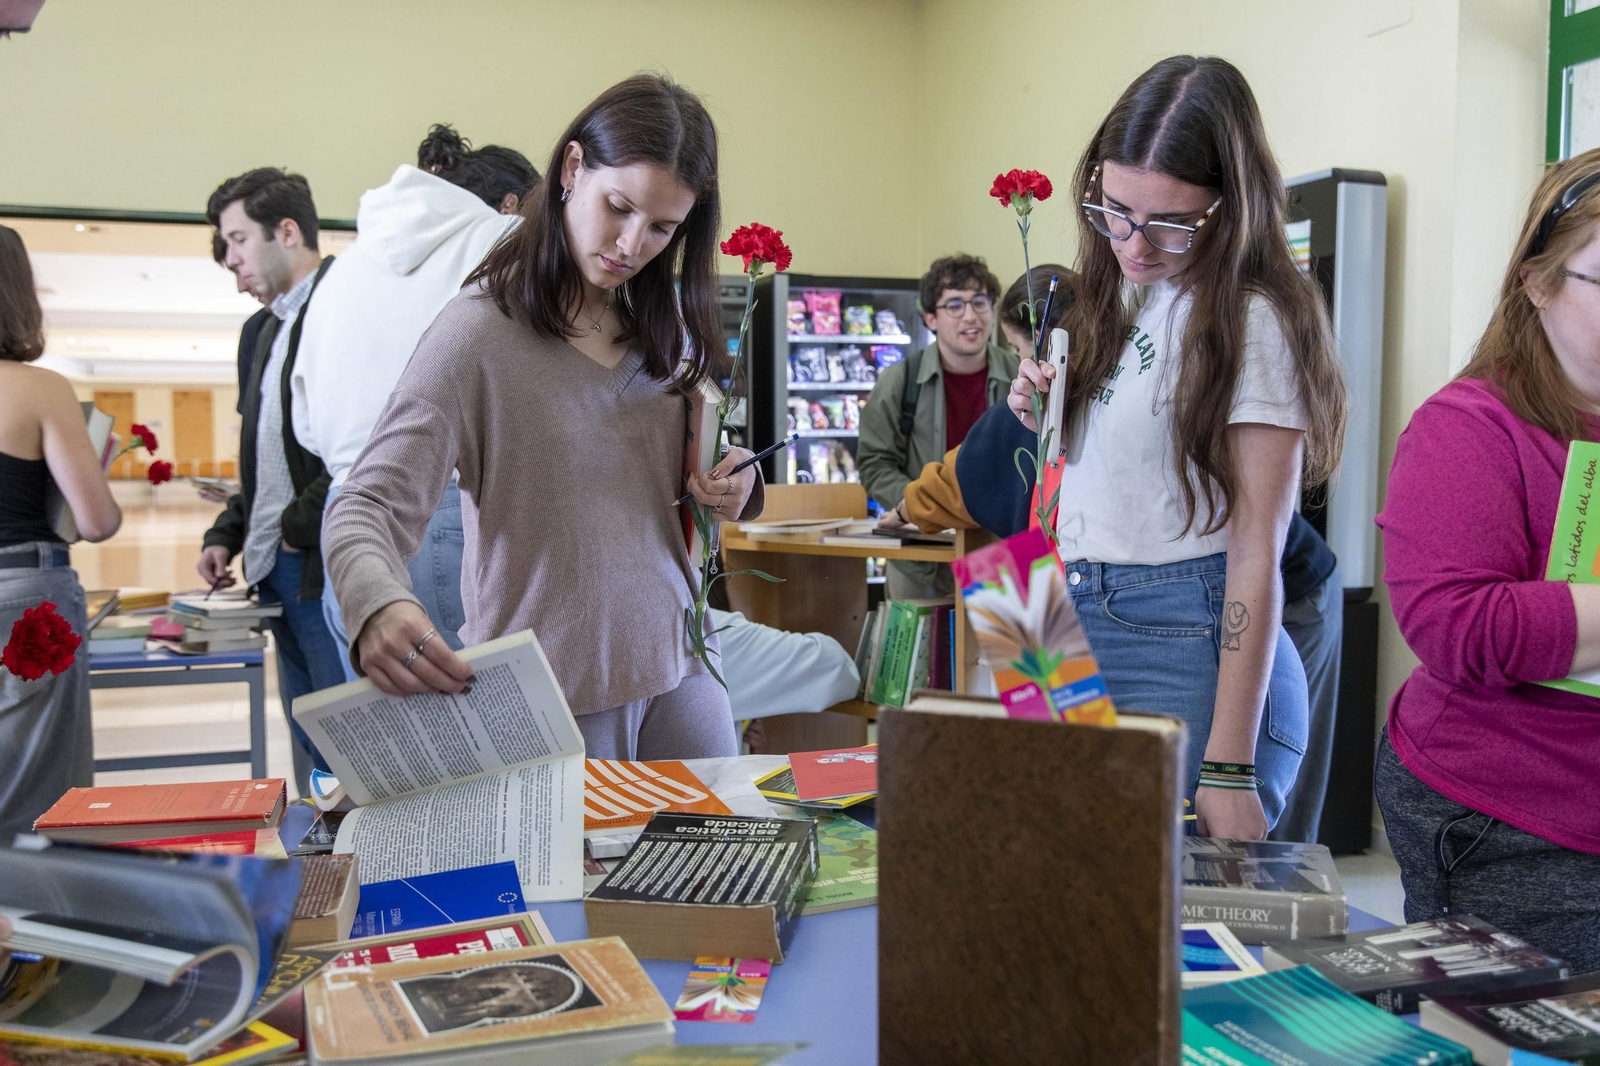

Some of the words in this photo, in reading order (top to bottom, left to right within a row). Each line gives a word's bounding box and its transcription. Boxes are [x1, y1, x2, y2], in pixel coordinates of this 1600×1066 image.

[1583, 459, 1598, 489] alba
[1576, 493, 1591, 516] del
[675, 826, 779, 836] estadística
[704, 820, 782, 830] aplicada
[1212, 905, 1271, 922] THEORY
[1254, 923, 1285, 931] APPROACH
